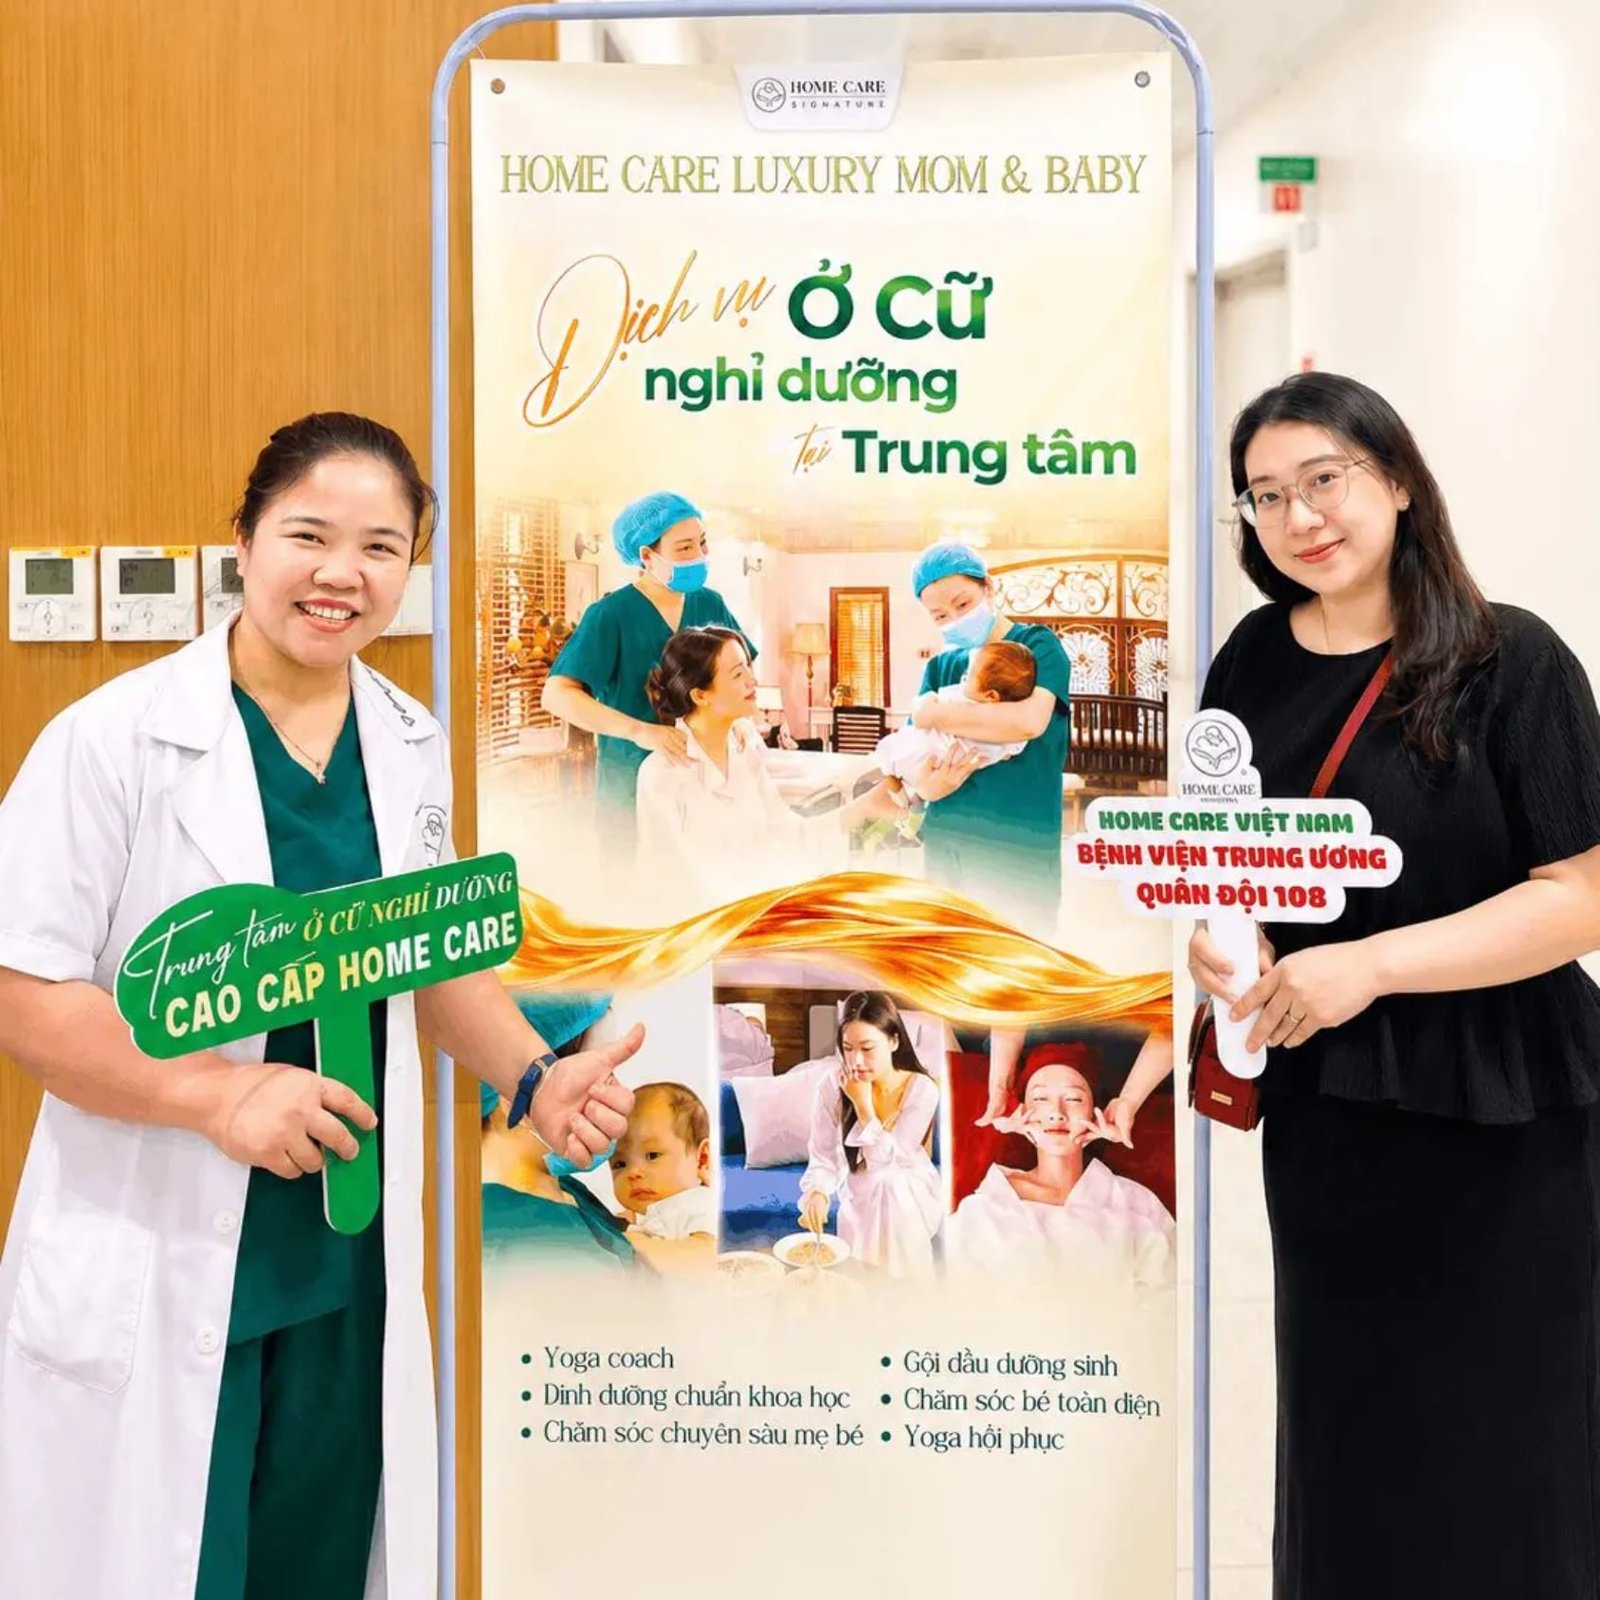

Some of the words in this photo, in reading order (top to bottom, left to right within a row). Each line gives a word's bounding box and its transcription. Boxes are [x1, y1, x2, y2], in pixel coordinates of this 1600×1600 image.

[790, 81, 837, 93] HOME
[843, 81, 886, 93] CARE
[500, 154, 609, 194] HOME
[621, 154, 720, 194] CARE
[732, 155, 883, 194] LUXURY
[895, 155, 988, 194] MOM
[1001, 154, 1032, 194] &
[1044, 154, 1147, 194] BABY
[523, 249, 699, 428] Dịch
[712, 276, 776, 328] vụ
[788, 258, 854, 340] Ở
[876, 270, 994, 340] Cữ
[645, 352, 765, 412] nghỉ
[777, 356, 957, 413] dưỡng
[842, 430, 1007, 486] Trung
[1022, 428, 1136, 475] tâm
[1182, 783, 1221, 796] HOME
[1222, 783, 1256, 796] CARE
[1098, 811, 1163, 830] HOME
[1169, 812, 1229, 832] CARE
[1235, 806, 1290, 837] VIỆT
[1296, 813, 1353, 833] NAM
[1077, 838, 1143, 871] BỆNH
[1147, 839, 1207, 872] VIỆN
[1213, 846, 1303, 869] TRUNG
[1309, 844, 1387, 869] ƯƠNG
[1136, 877, 1211, 910] QUÂN
[1215, 878, 1268, 914] ĐỘI
[1273, 885, 1327, 908] 108
[123, 909, 237, 1020] Trung
[303, 907, 325, 942] Ở
[329, 899, 366, 936] CỮ
[368, 882, 431, 928] NGHỈ
[434, 871, 513, 910] DƯỠNG
[165, 984, 241, 1038] CAO
[257, 951, 325, 1013] CẤP
[339, 932, 431, 992] HOME
[444, 911, 517, 962] CARE
[544, 1346, 600, 1374] Yoga
[608, 1346, 674, 1369] coach
[904, 1350, 940, 1377] Gội
[948, 1347, 988, 1374] dầu
[997, 1352, 1066, 1381] dưỡng
[1073, 1354, 1119, 1377] sinh
[544, 1383, 592, 1406] Dinh
[599, 1383, 668, 1412] dưỡng
[675, 1380, 741, 1407] chuẩn
[749, 1385, 802, 1408] khoa
[810, 1385, 851, 1413] học
[904, 1387, 968, 1411] Chăm
[975, 1389, 1015, 1412] sóc
[1022, 1389, 1050, 1412] bé
[1058, 1390, 1107, 1414] toàn
[1114, 1392, 1161, 1420] diện
[544, 1419, 607, 1443] Chăm
[614, 1421, 654, 1443] sóc
[661, 1421, 741, 1450] chuyên
[794, 1428, 829, 1450] mẹ
[836, 1423, 864, 1446] bé
[904, 1424, 961, 1454] Yoga
[1010, 1426, 1065, 1454] phục
